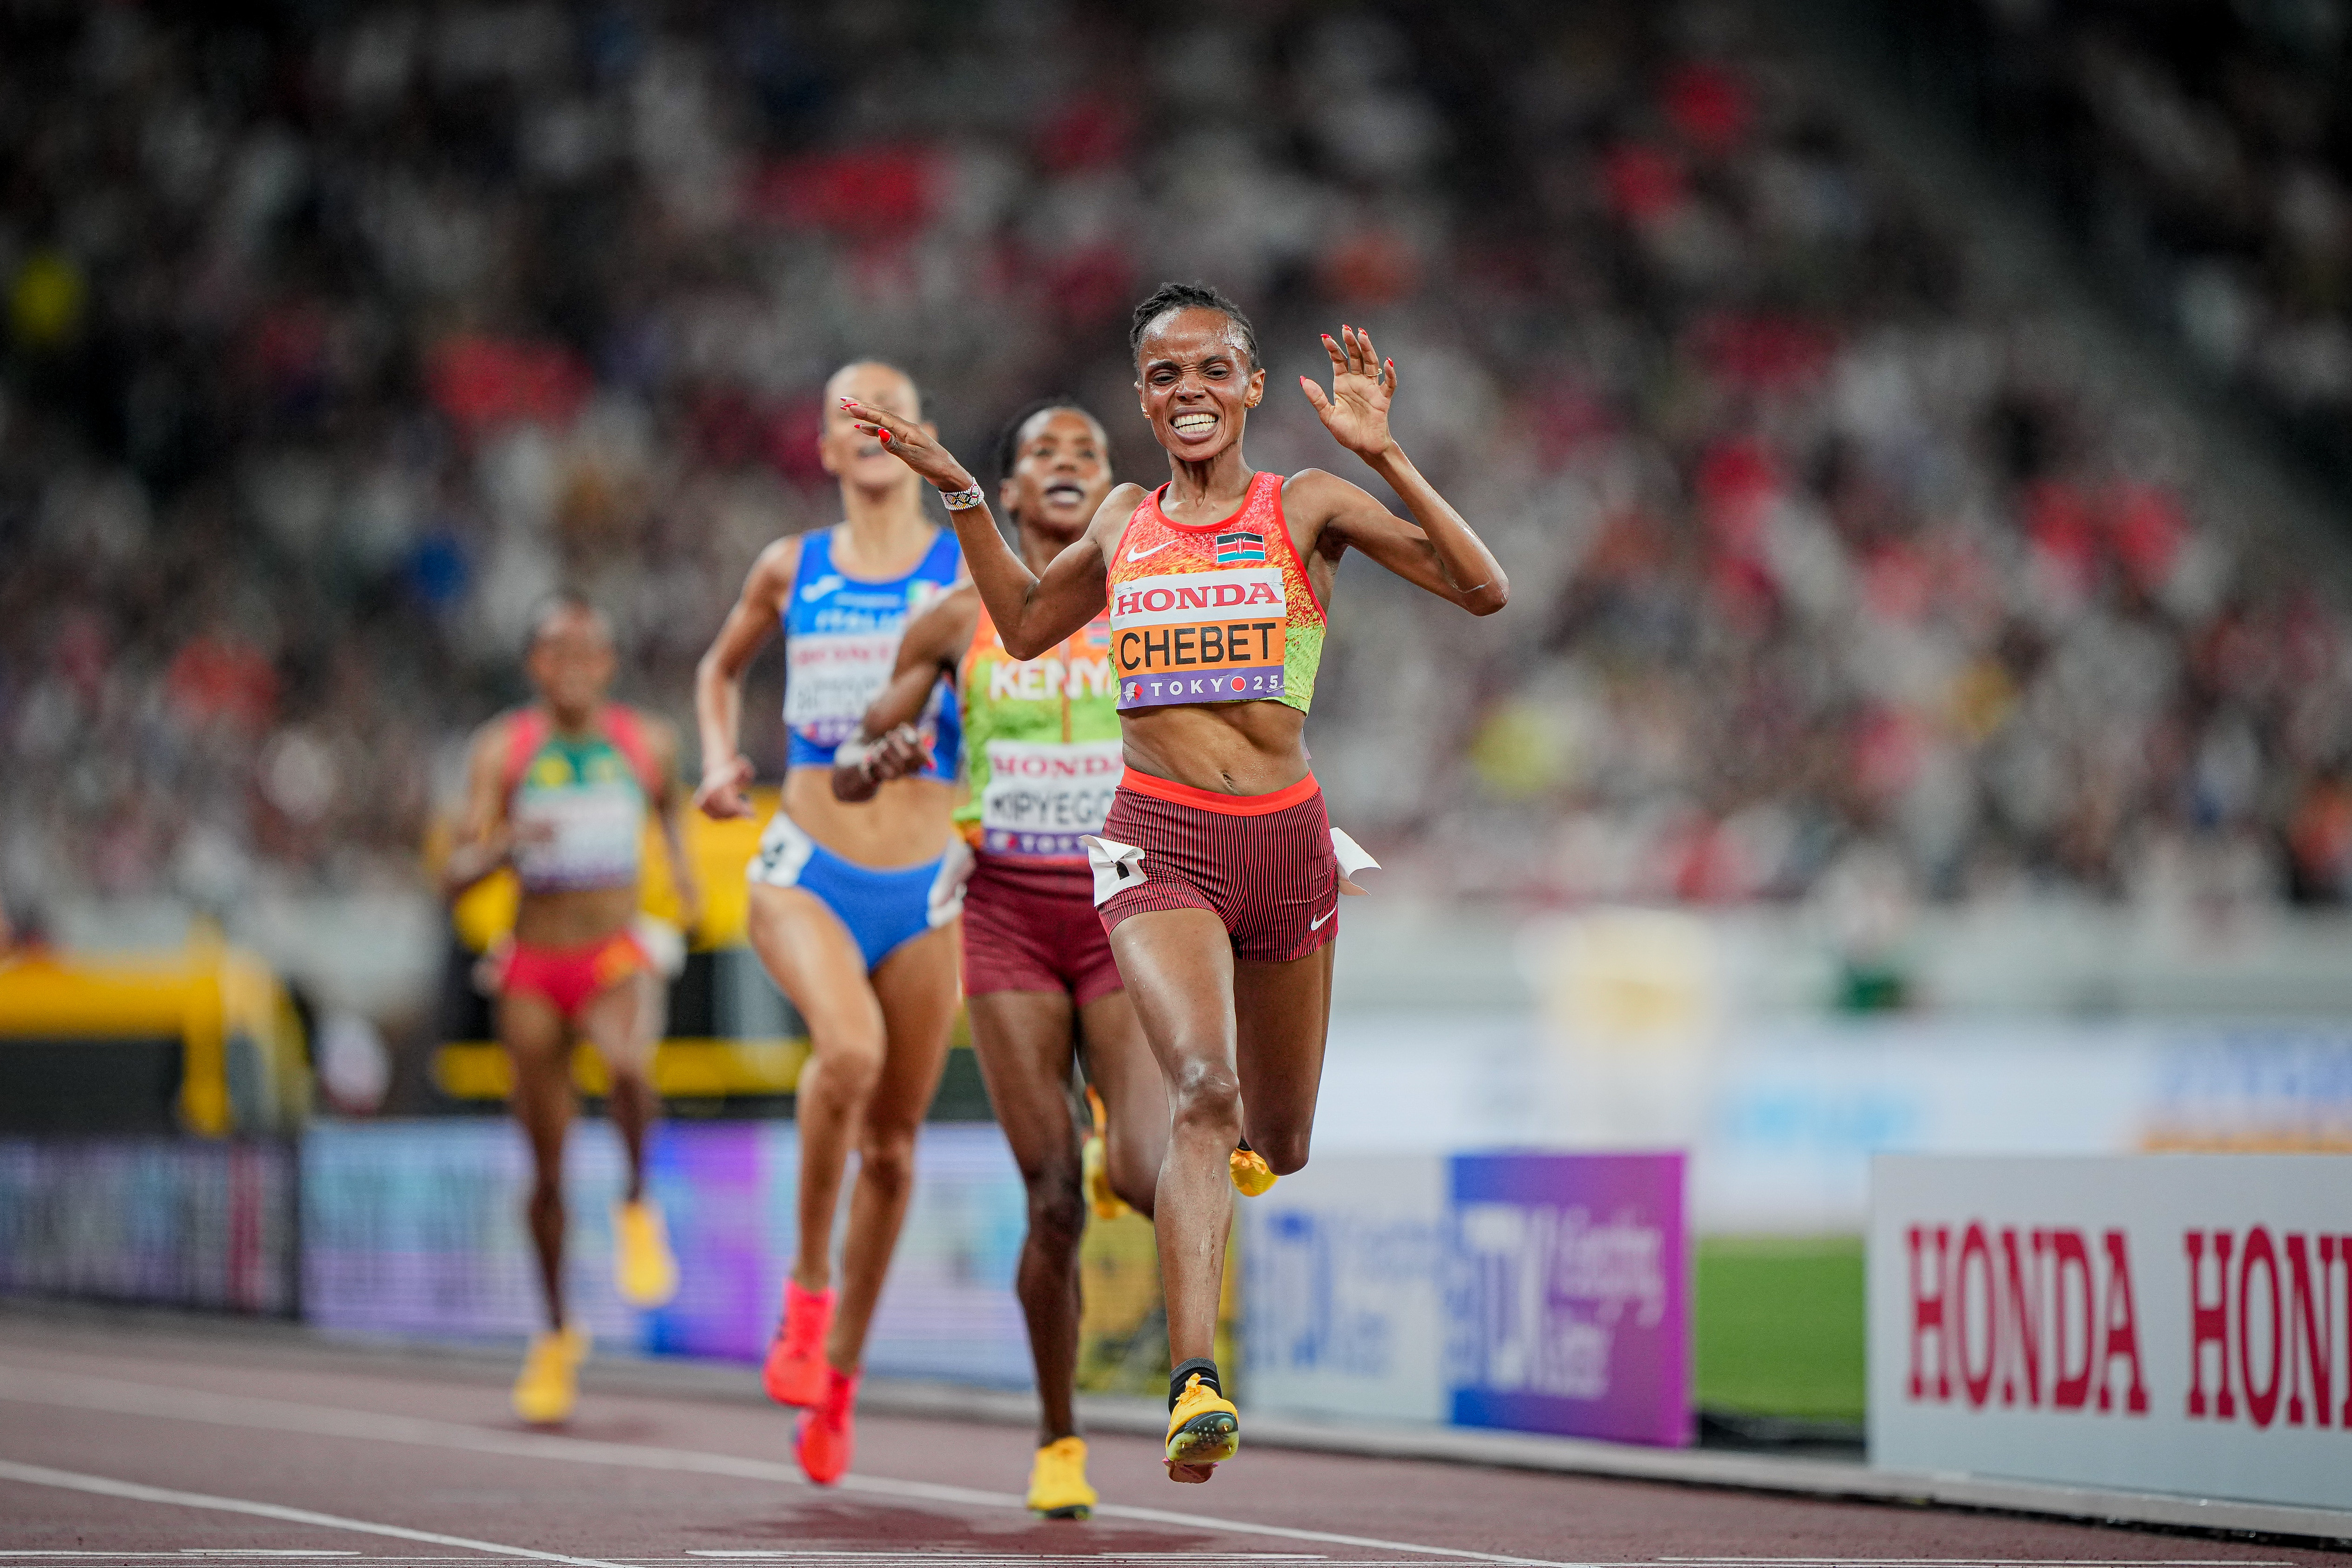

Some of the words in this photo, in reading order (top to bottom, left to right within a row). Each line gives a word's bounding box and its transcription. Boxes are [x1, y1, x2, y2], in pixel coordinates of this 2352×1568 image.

[1114, 583, 1282, 617] HONDA
[1120, 622, 1276, 670] CHEBET
[990, 657, 1112, 701] KENY
[1905, 1218, 2151, 1414] HONDA
